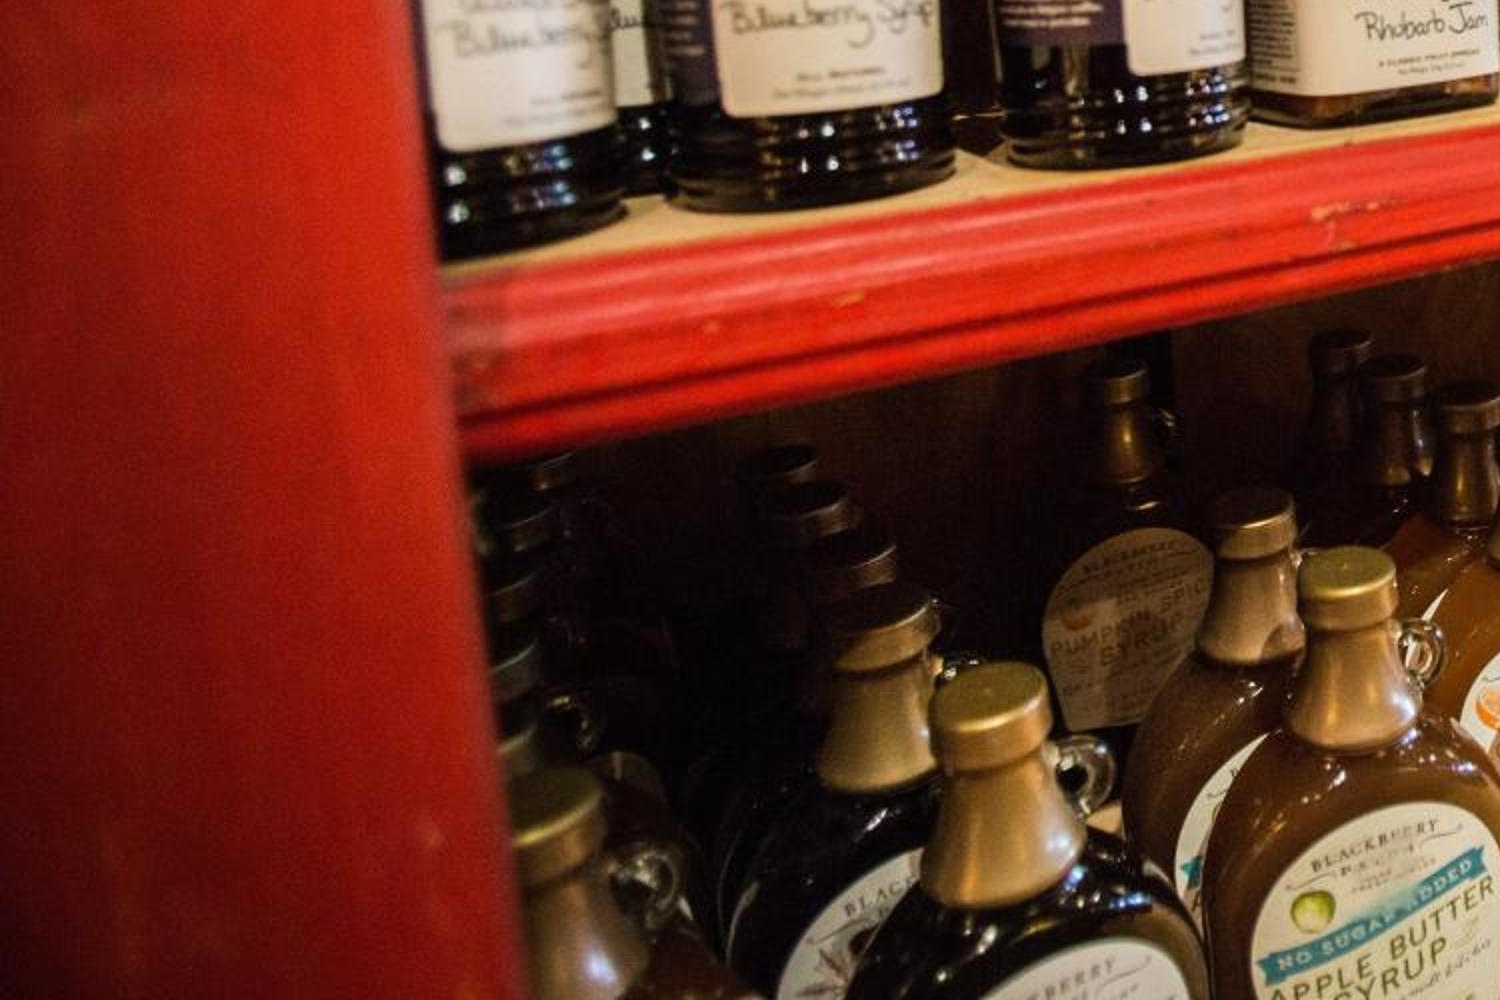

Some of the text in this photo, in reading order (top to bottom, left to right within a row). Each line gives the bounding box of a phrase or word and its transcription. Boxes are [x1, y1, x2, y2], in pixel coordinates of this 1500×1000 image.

[1352, 0, 1489, 41] Rhubarb Jam
[1160, 577, 1210, 613] SPIC
[1310, 818, 1440, 873] BLACKBERRY
[1266, 874, 1496, 1000] APPLE BUTTER
[1277, 950, 1313, 972] NO
[1320, 908, 1397, 955] SUGAR
